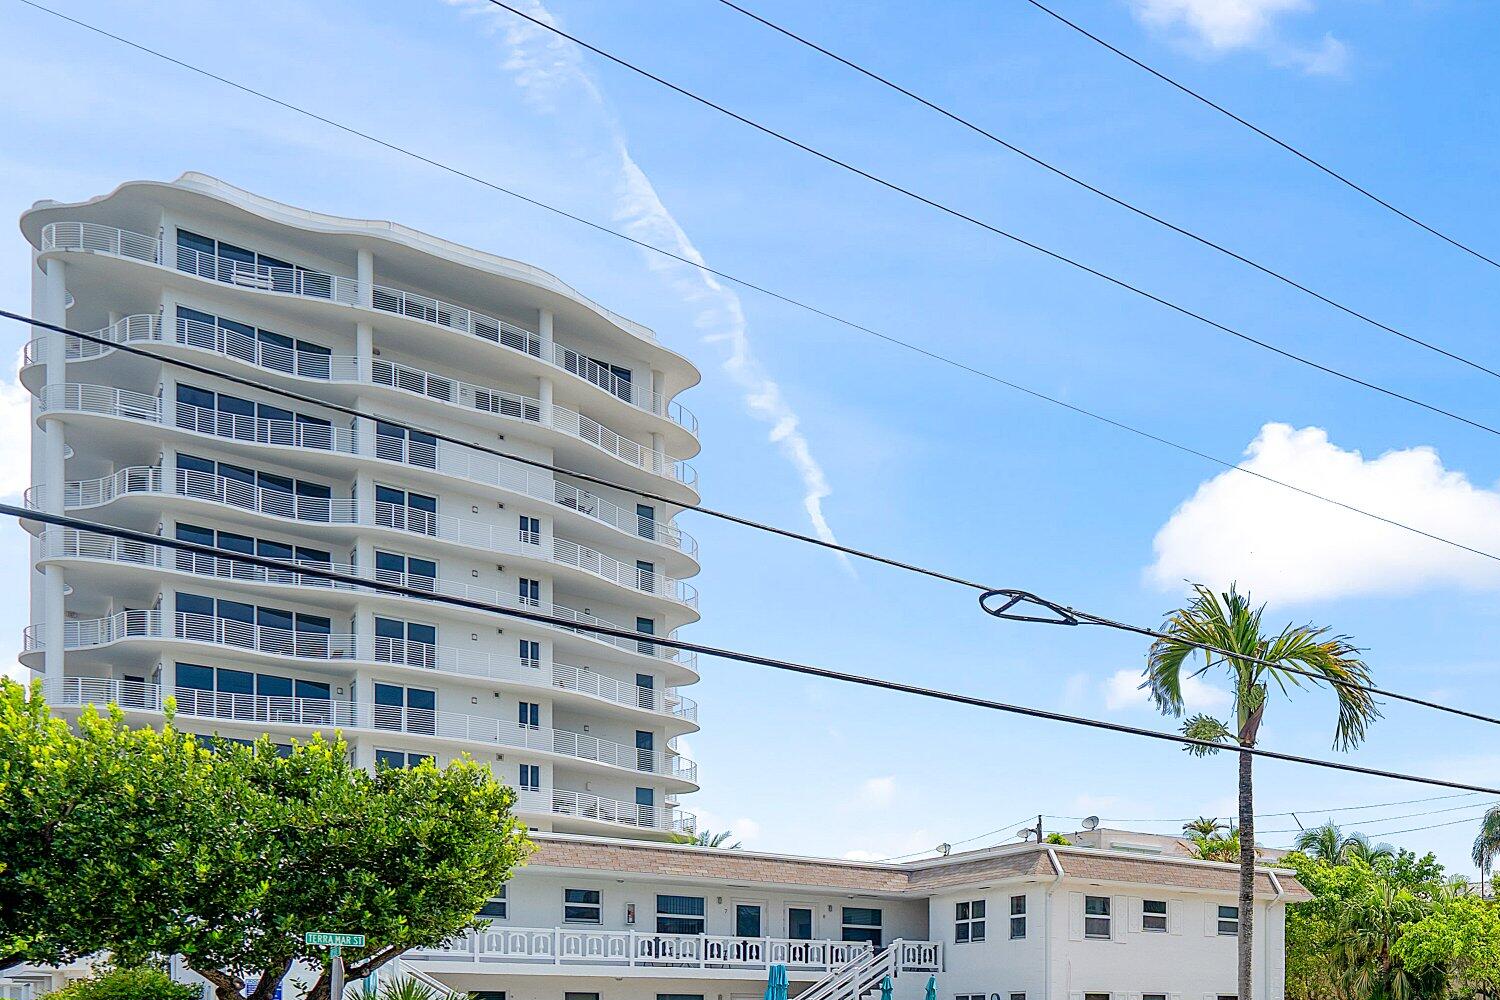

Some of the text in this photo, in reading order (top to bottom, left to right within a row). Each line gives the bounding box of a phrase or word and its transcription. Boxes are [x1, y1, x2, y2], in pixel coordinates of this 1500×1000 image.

[308, 934, 362, 945] TERRA MAR ST
